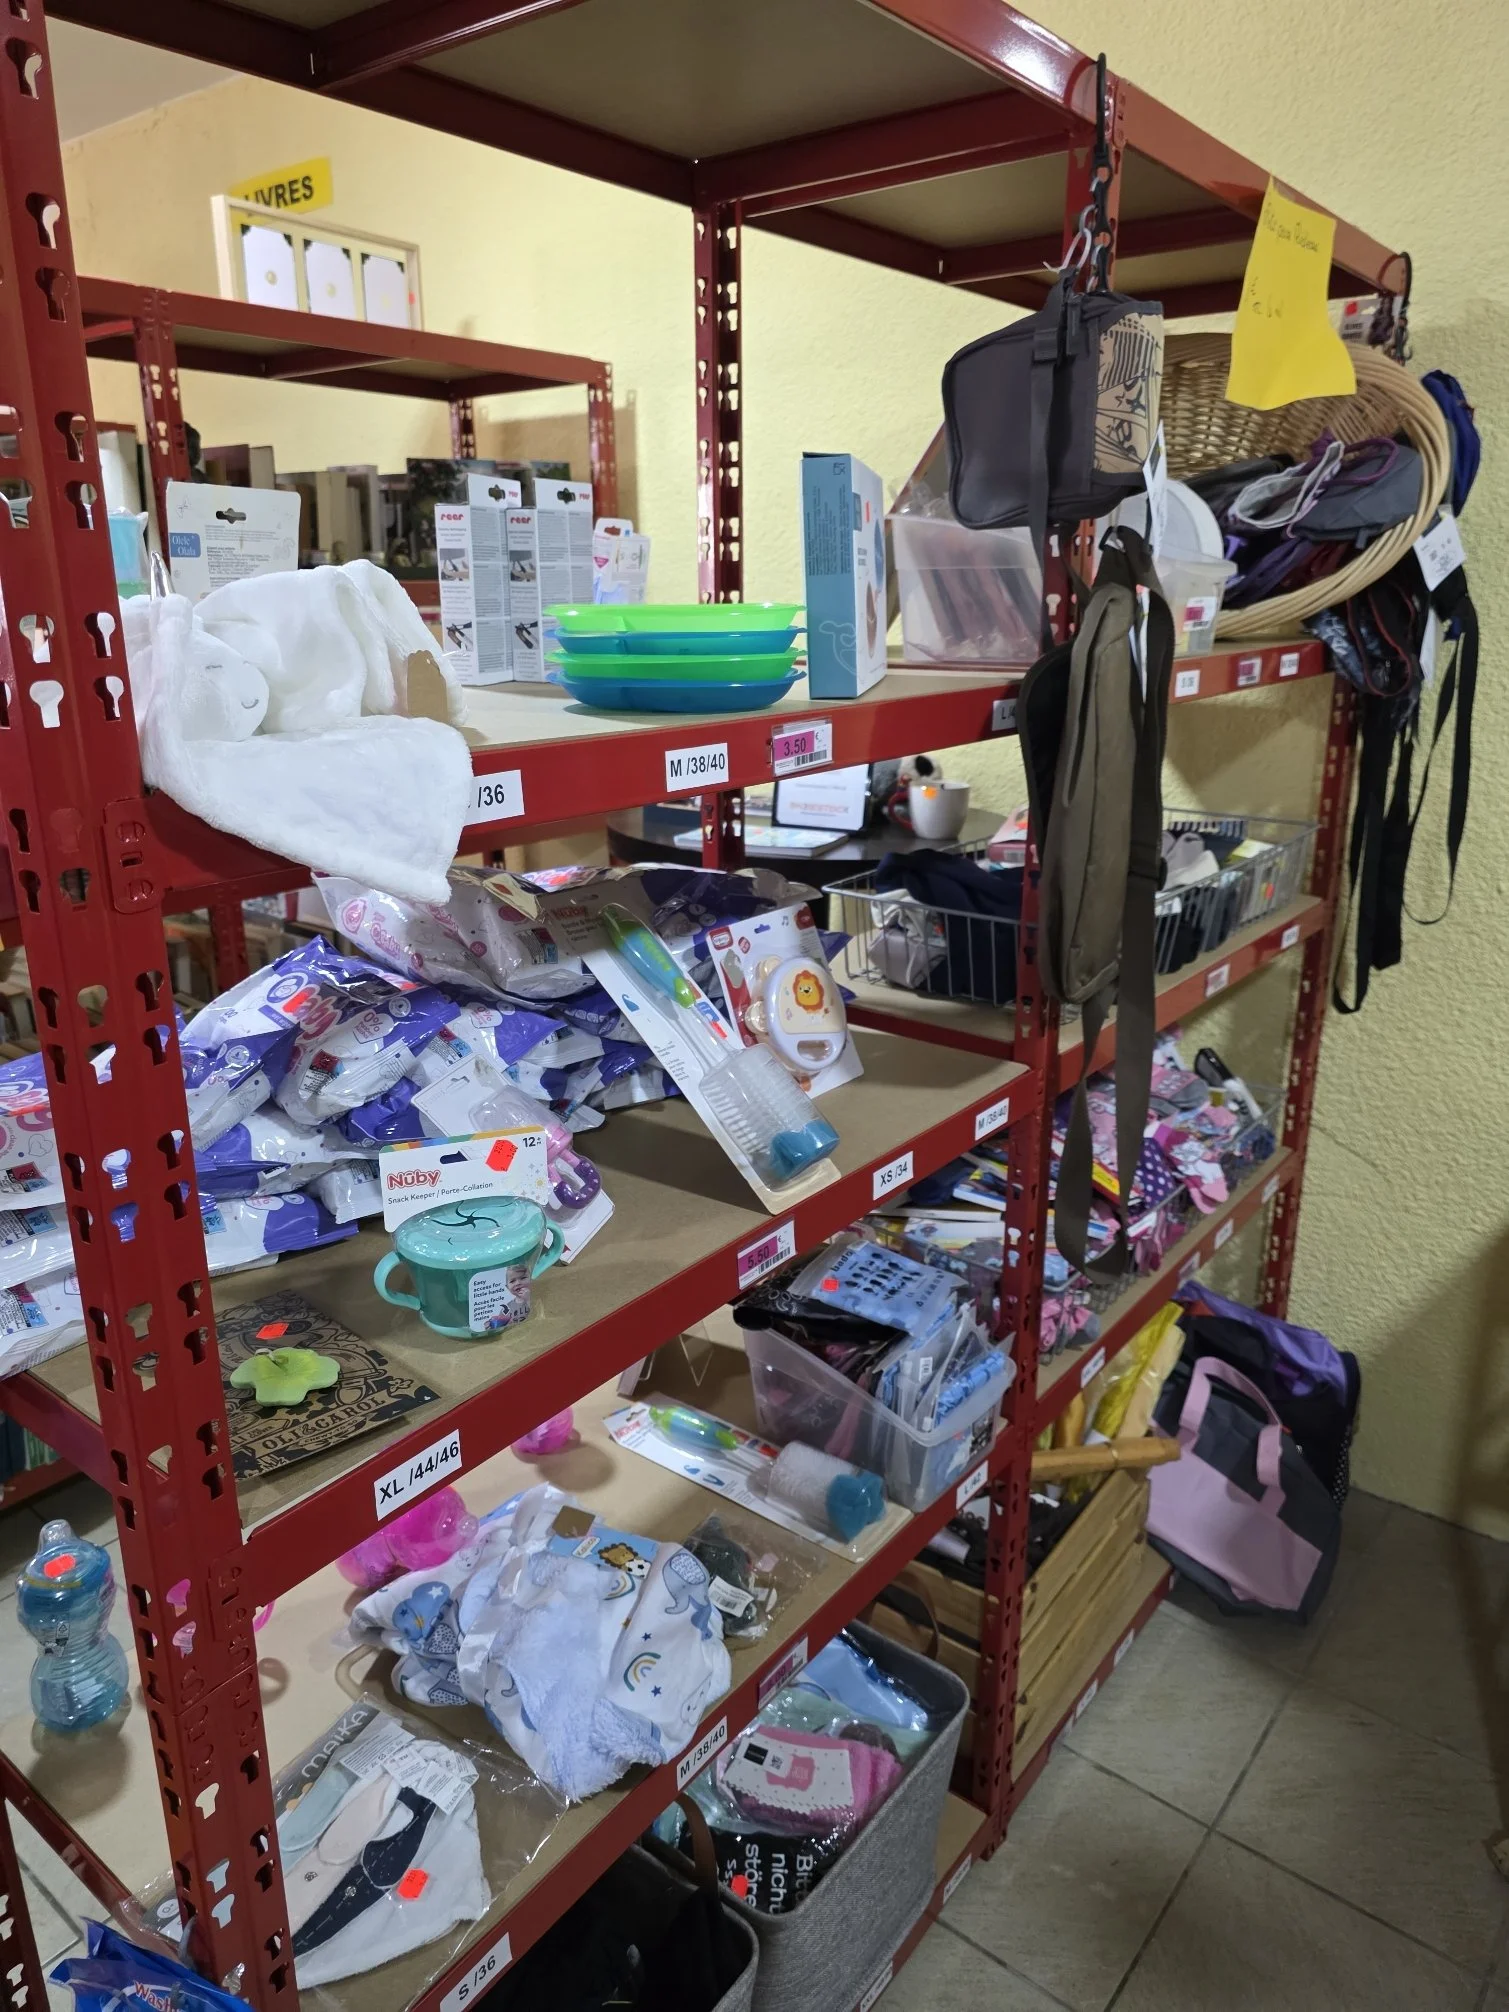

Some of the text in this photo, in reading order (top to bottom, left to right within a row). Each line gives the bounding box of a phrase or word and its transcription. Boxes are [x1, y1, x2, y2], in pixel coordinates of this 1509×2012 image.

[245, 175, 314, 209] IVRES
[440, 513, 465, 521] reer
[510, 516, 532, 525] reer
[784, 737, 807, 757] 3.50
[670, 752, 726, 778] M /38/40
[477, 783, 505, 808] /36
[363, 1011, 384, 1033] 0%
[880, 1161, 908, 1188] XS /34
[388, 1194, 409, 1205] Snack
[410, 1191, 435, 1203] Keeper
[441, 1181, 494, 1196] Porte-Collation
[747, 1245, 770, 1269] 5.50
[262, 1396, 387, 1450] OLI&CAROL
[379, 1440, 459, 1504] XL /44/46
[679, 1724, 726, 1779] M /38/40
[458, 1955, 496, 2001] S /36
